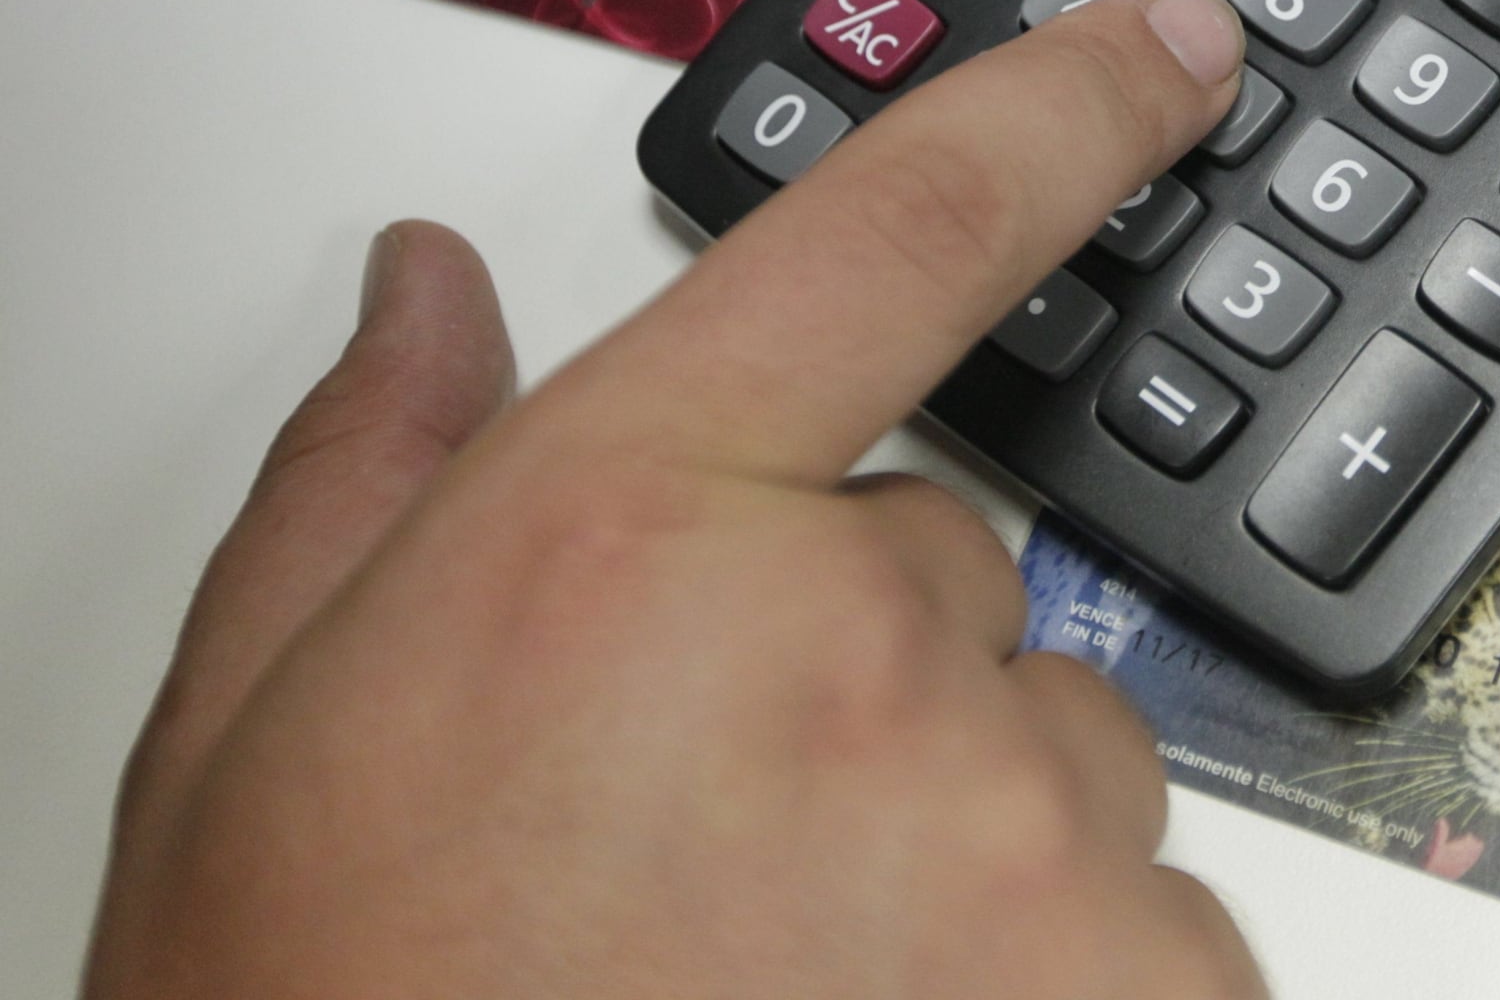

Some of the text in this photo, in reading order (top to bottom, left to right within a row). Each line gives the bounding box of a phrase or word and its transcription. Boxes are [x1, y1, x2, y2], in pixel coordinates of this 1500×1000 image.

[1393, 53, 1449, 106] 9
[754, 94, 806, 148] 0
[1312, 159, 1368, 212] 6
[1221, 259, 1281, 319] 3
[1070, 600, 1126, 631] VENCE
[1100, 578, 1137, 601] 4214
[1062, 621, 1119, 650] FIN DE
[1133, 628, 1225, 677] 11/17
[1155, 741, 1425, 849] solamente Electronic use only
